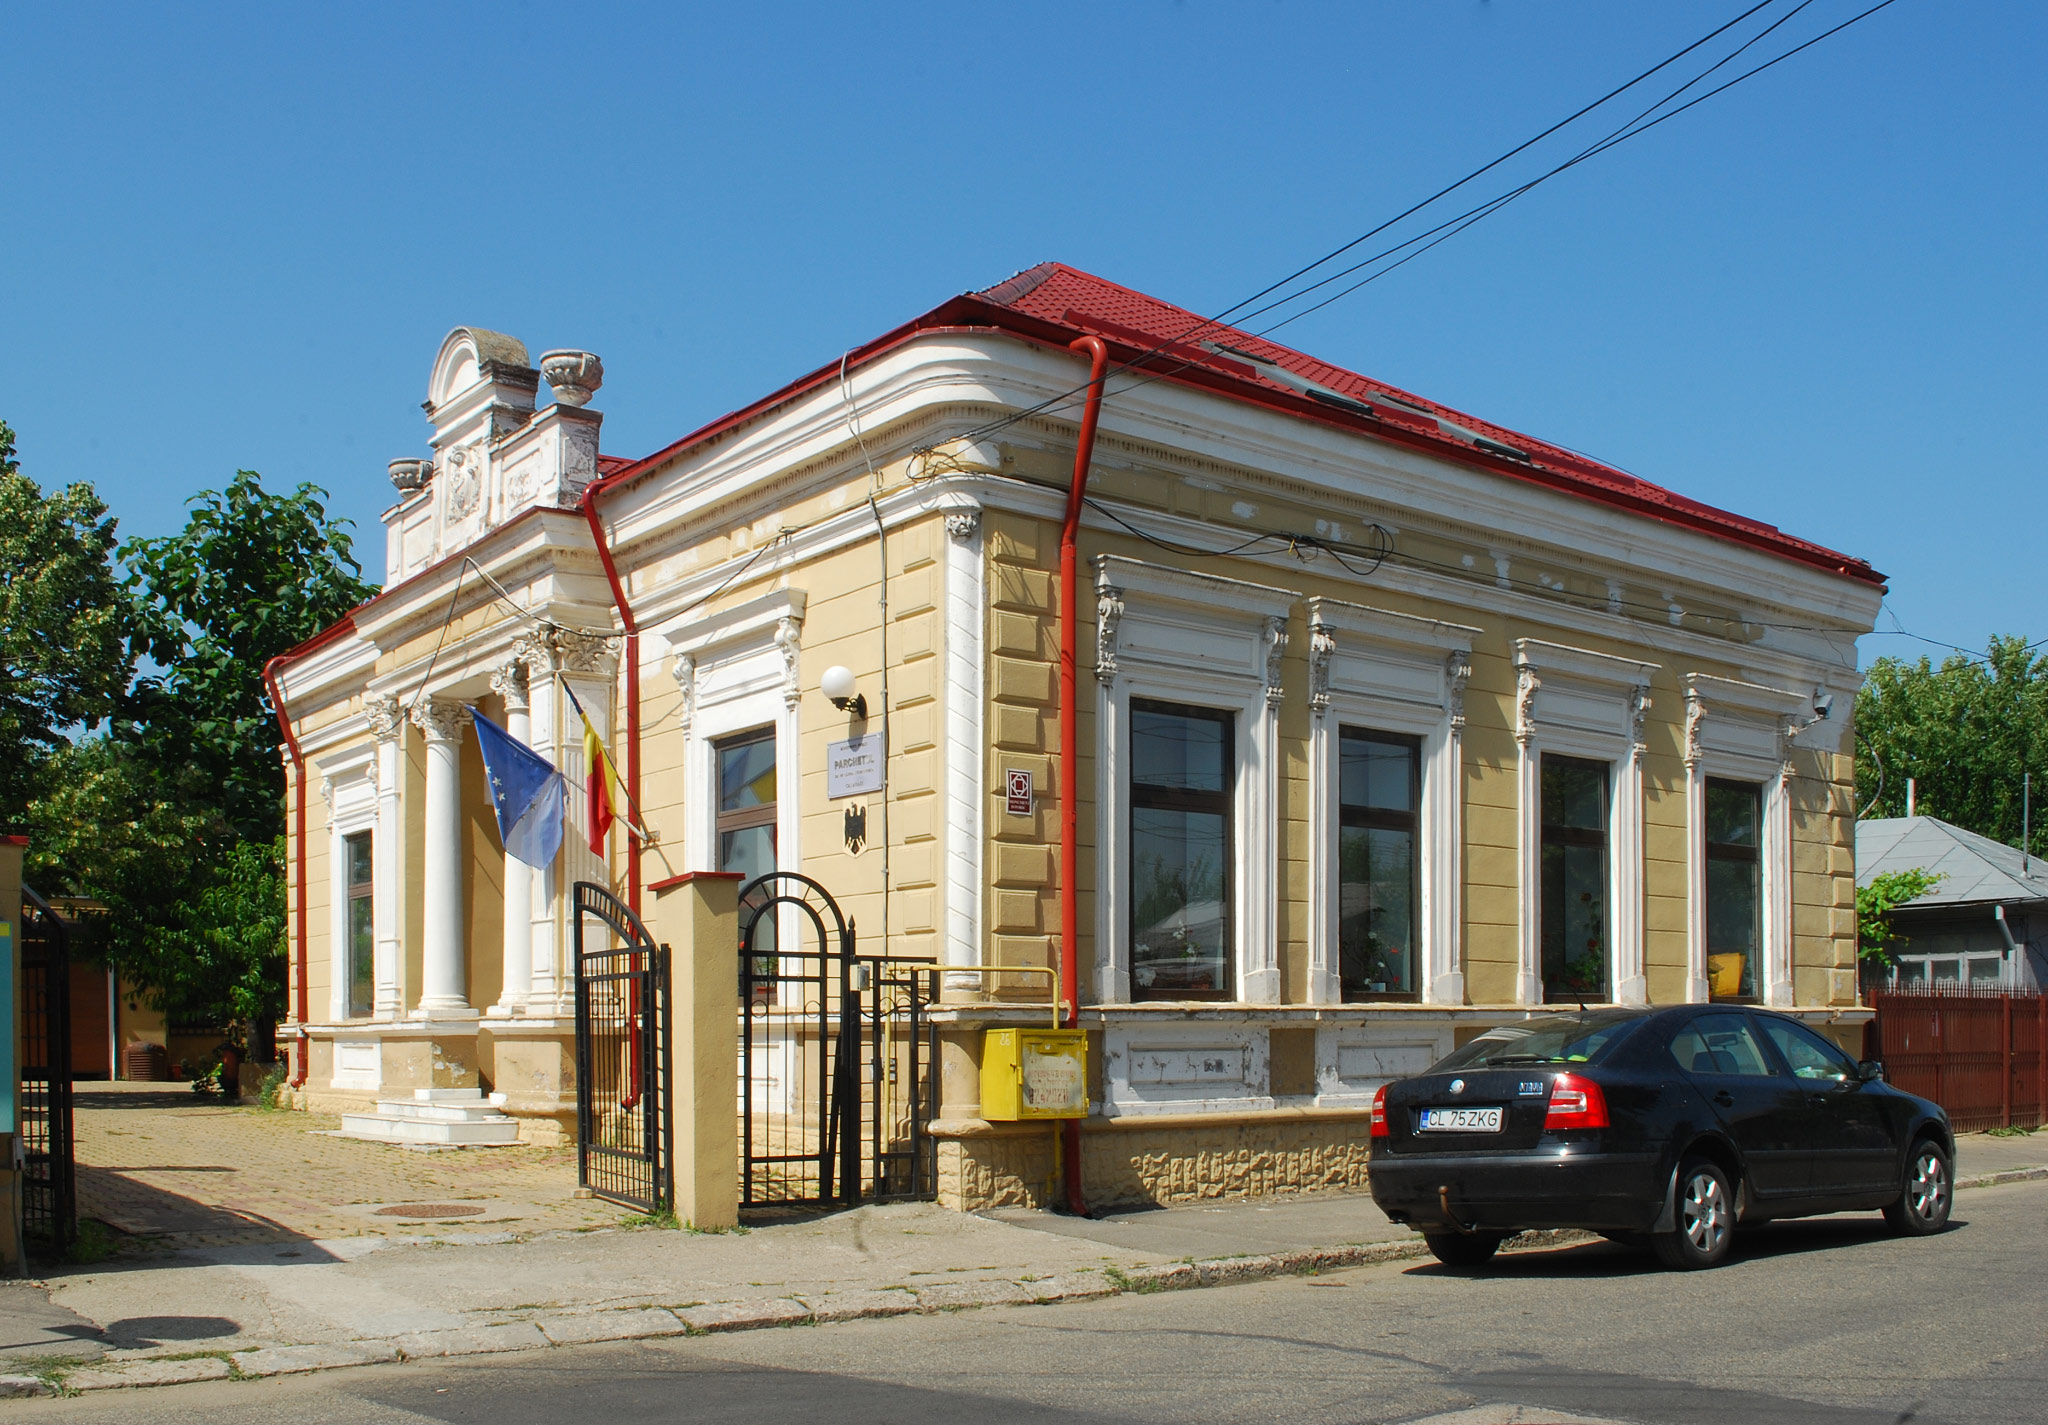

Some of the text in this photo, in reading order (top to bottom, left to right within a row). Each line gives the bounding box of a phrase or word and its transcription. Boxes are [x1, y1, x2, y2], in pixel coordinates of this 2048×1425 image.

[834, 754, 875, 770] PARCHETUL
[1429, 1111, 1498, 1126] CL 75ZKG
